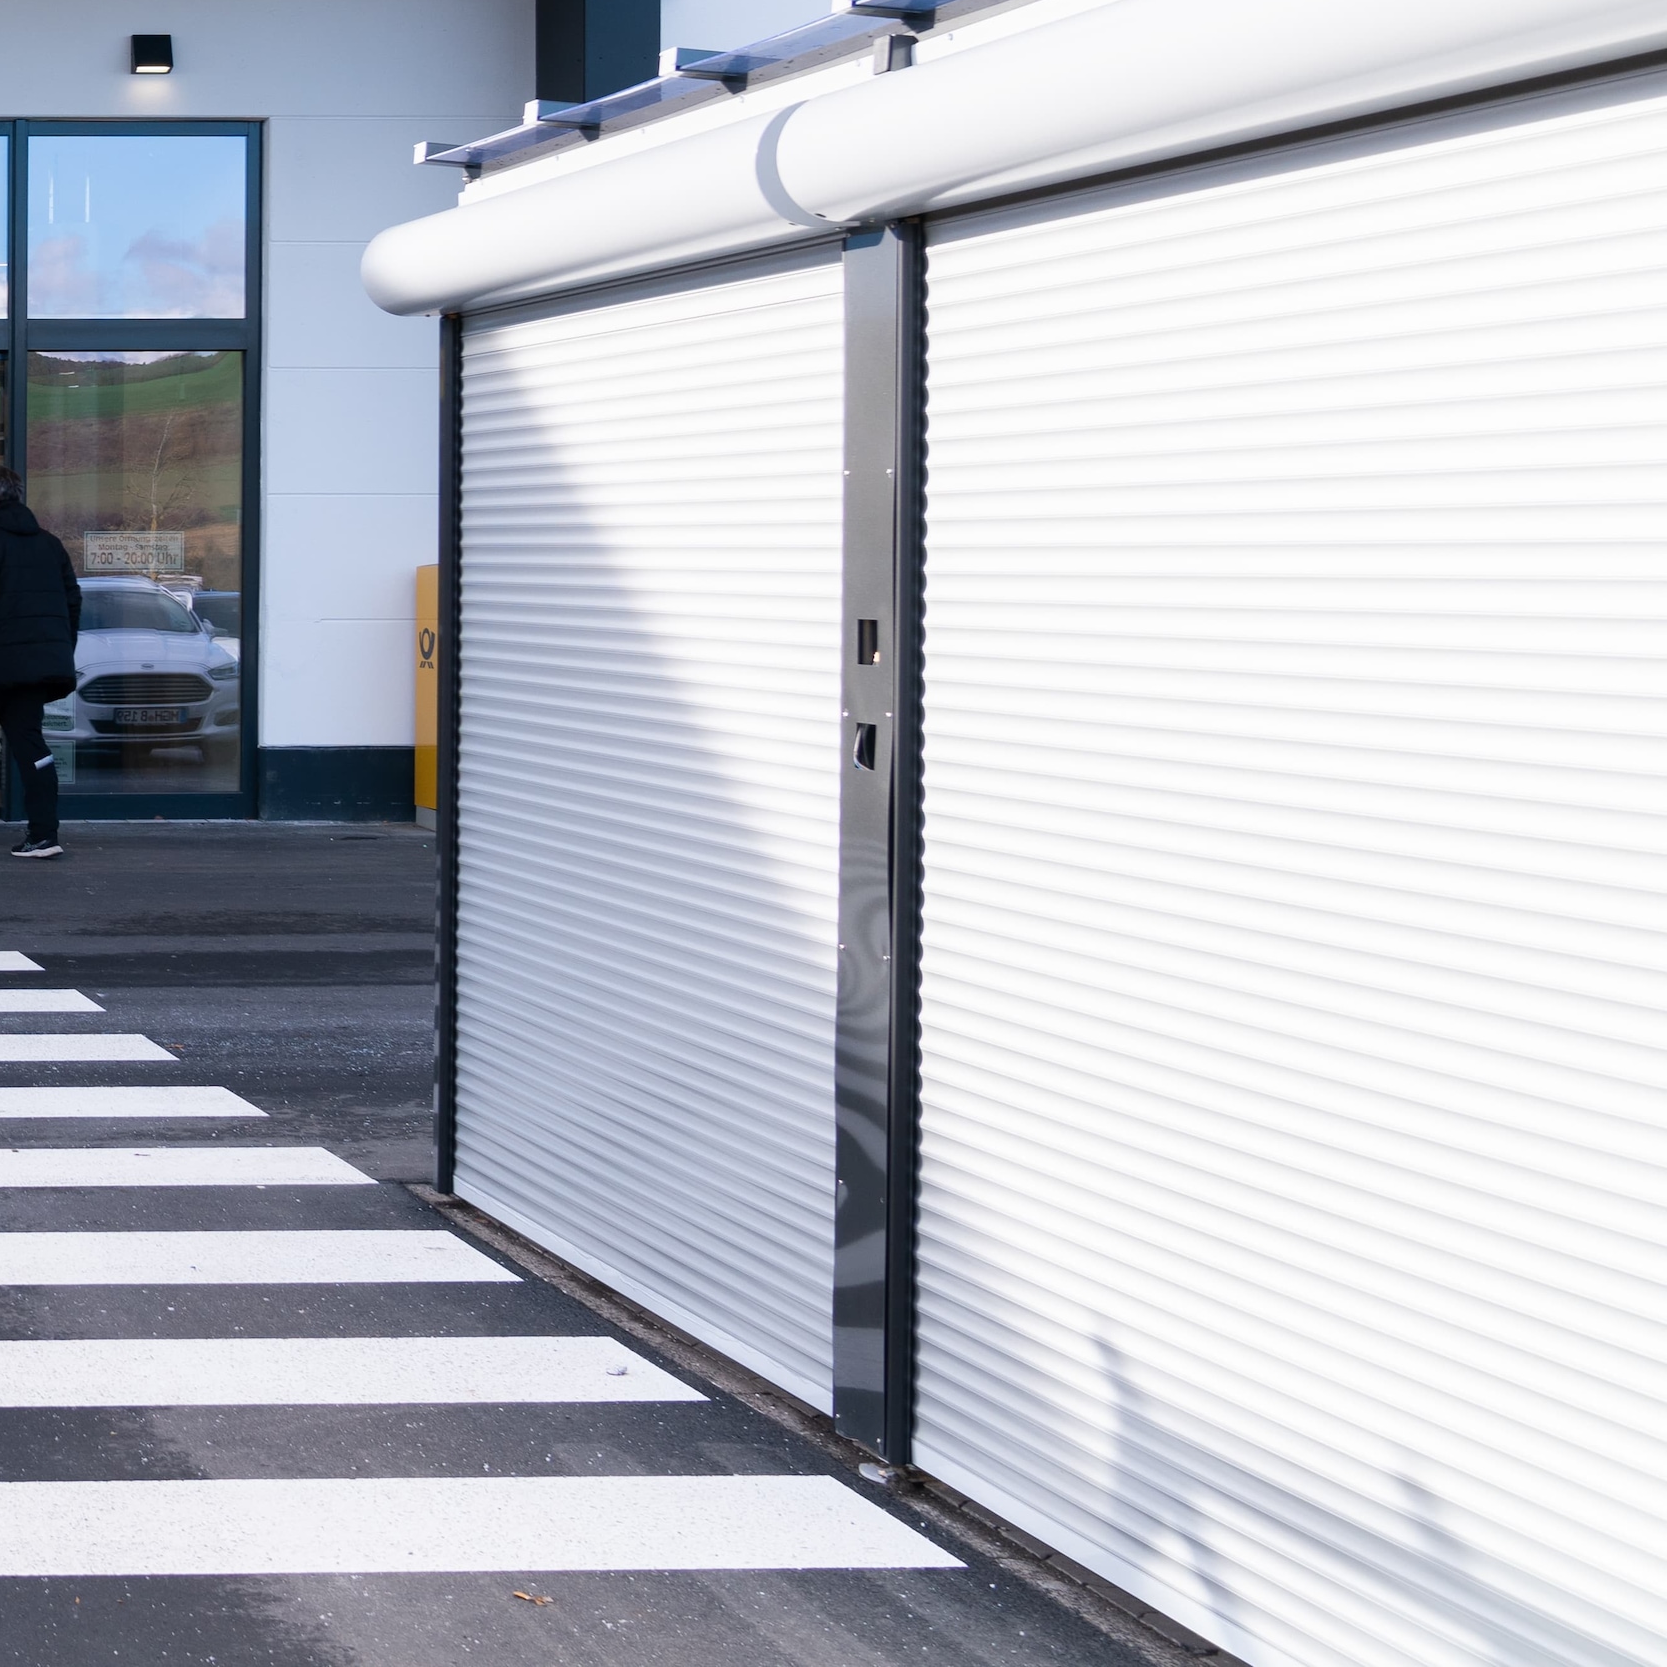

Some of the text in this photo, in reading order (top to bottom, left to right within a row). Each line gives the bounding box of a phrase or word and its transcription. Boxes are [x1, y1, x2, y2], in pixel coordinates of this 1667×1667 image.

[91, 552, 113, 564] 7:00
[124, 552, 154, 564] 20:00
[157, 552, 178, 564] Uhr
